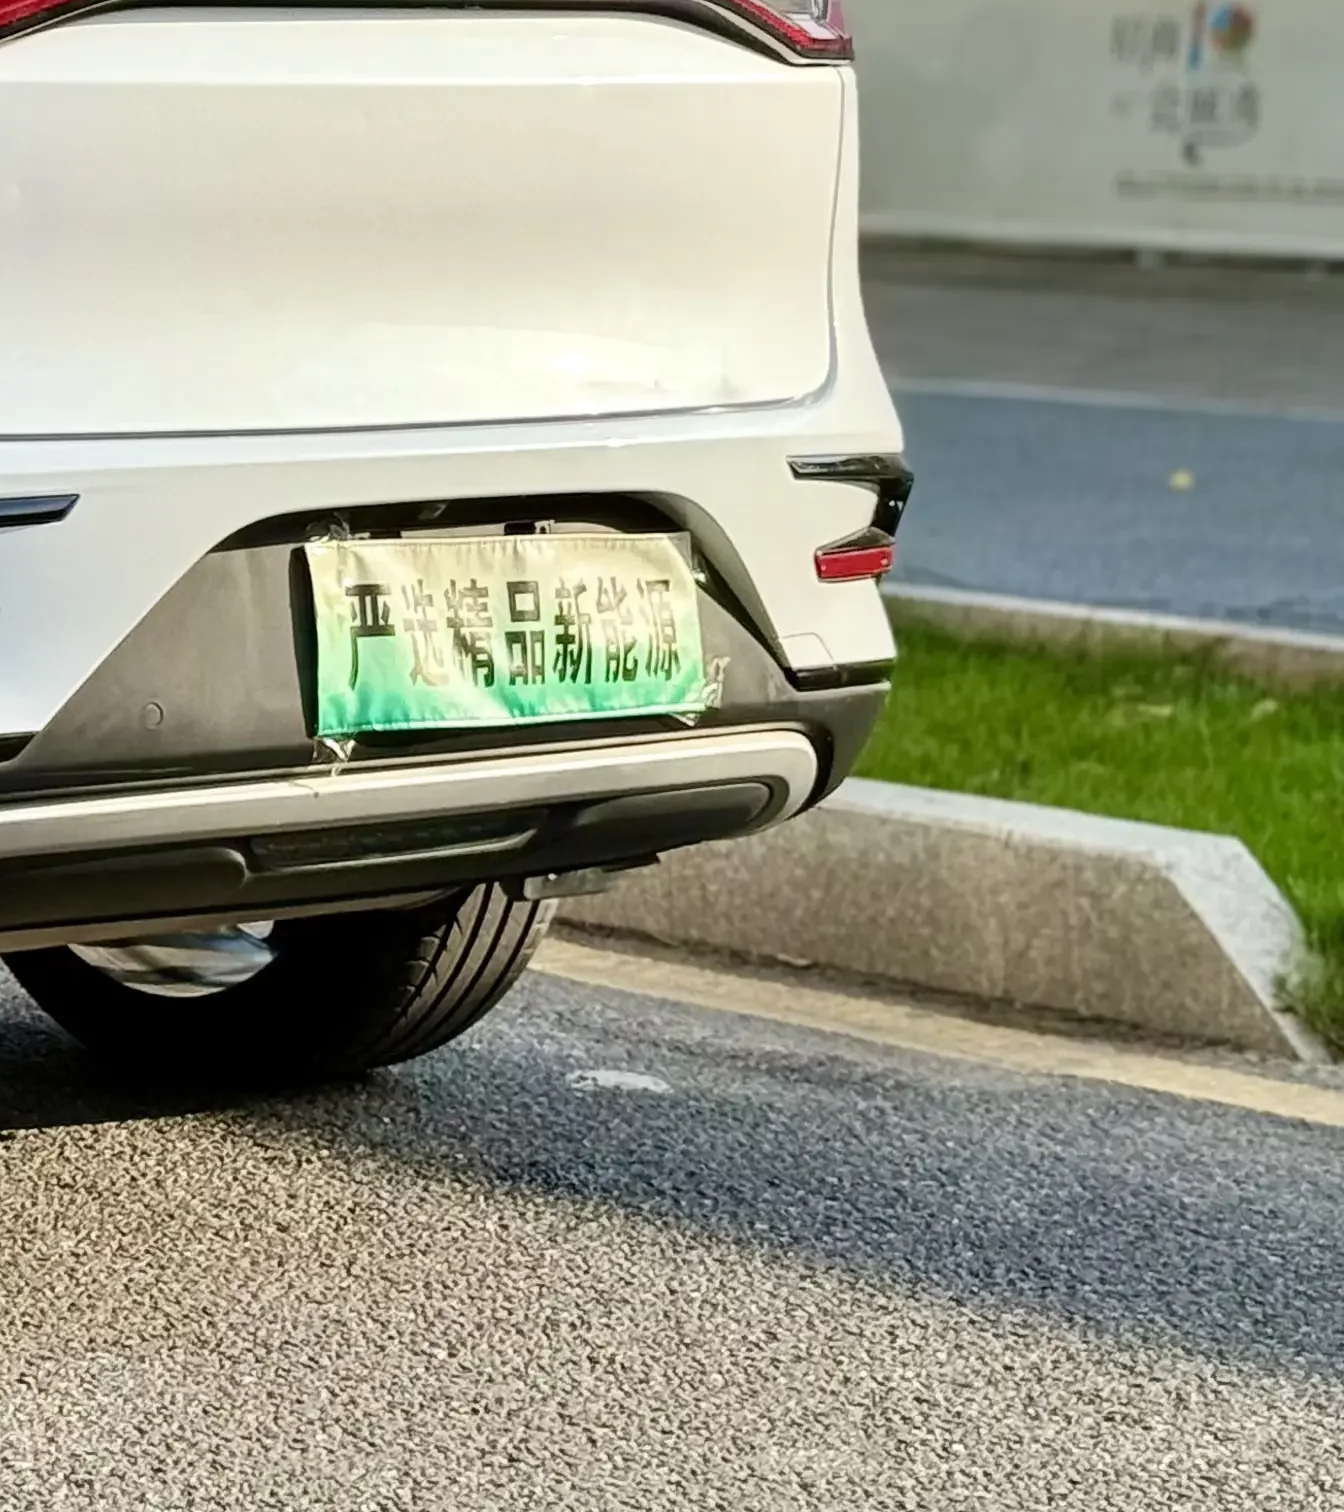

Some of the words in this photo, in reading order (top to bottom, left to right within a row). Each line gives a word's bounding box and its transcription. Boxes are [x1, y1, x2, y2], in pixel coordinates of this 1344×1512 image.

[345, 578, 681, 690] 严选精品新能源
